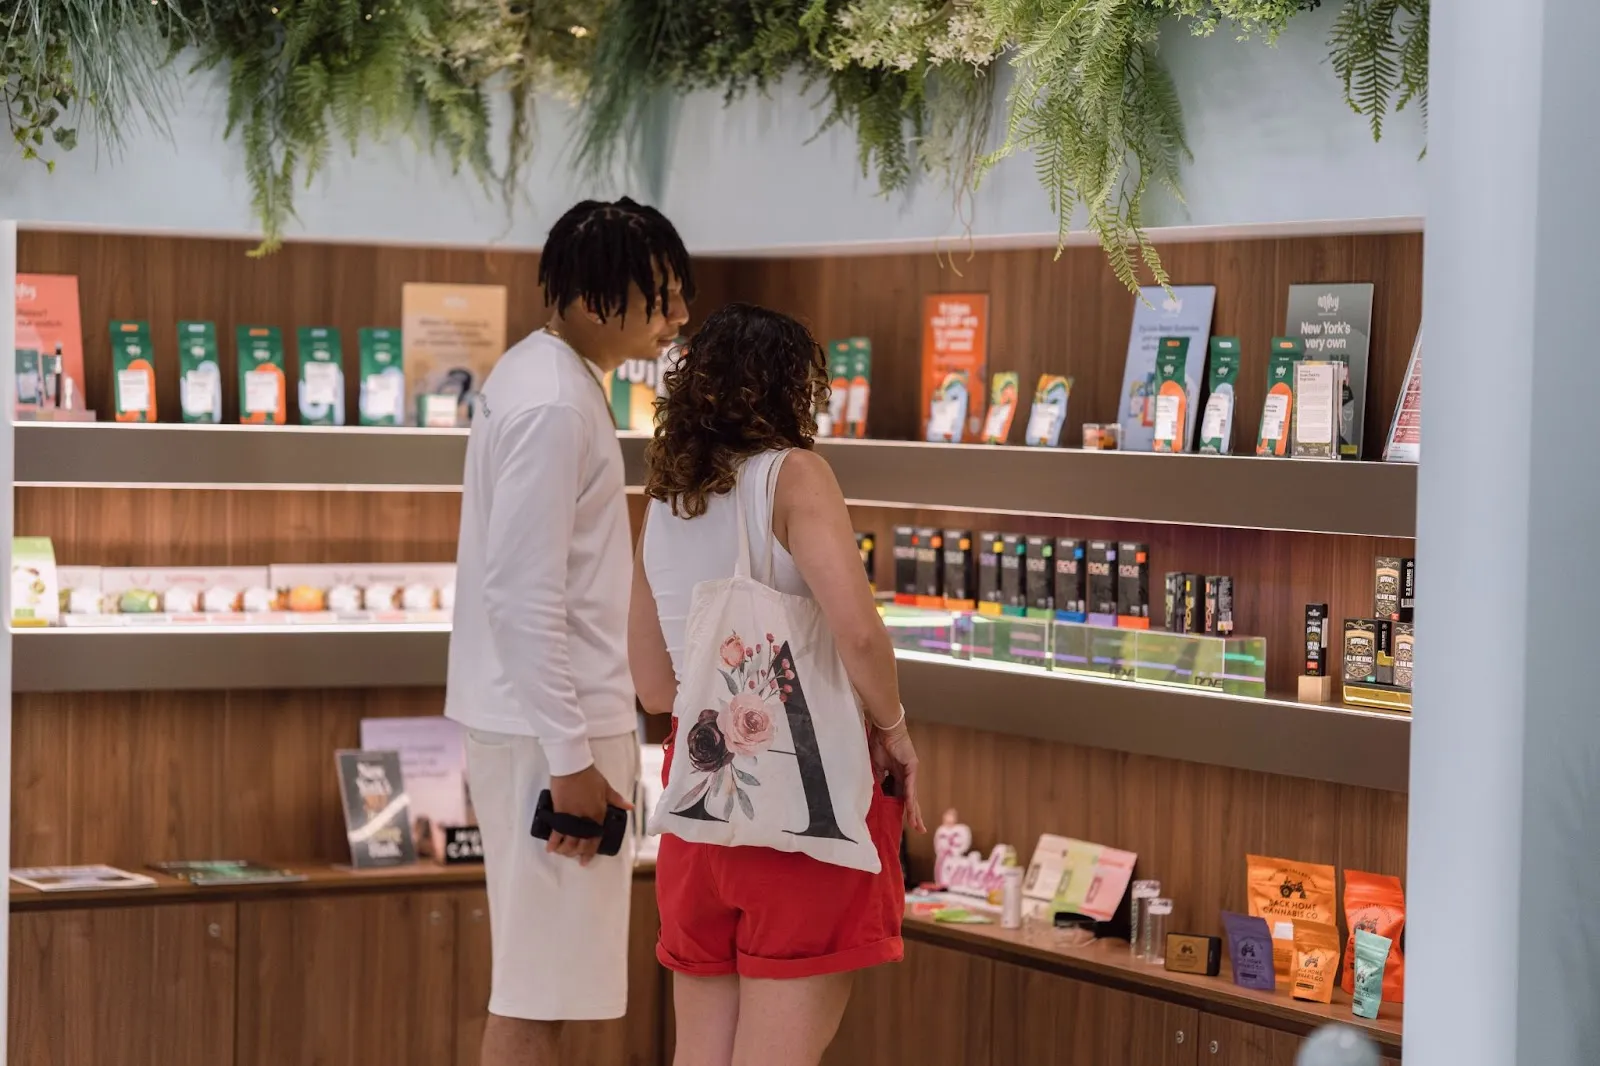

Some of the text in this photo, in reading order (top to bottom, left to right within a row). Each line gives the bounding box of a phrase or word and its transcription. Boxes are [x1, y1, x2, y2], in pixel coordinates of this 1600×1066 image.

[1300, 321, 1350, 334] New York's
[1305, 338, 1346, 352] very own
[669, 640, 859, 844] A
[1263, 907, 1304, 918] CANNABIS
[1292, 902, 1317, 911] HOME
